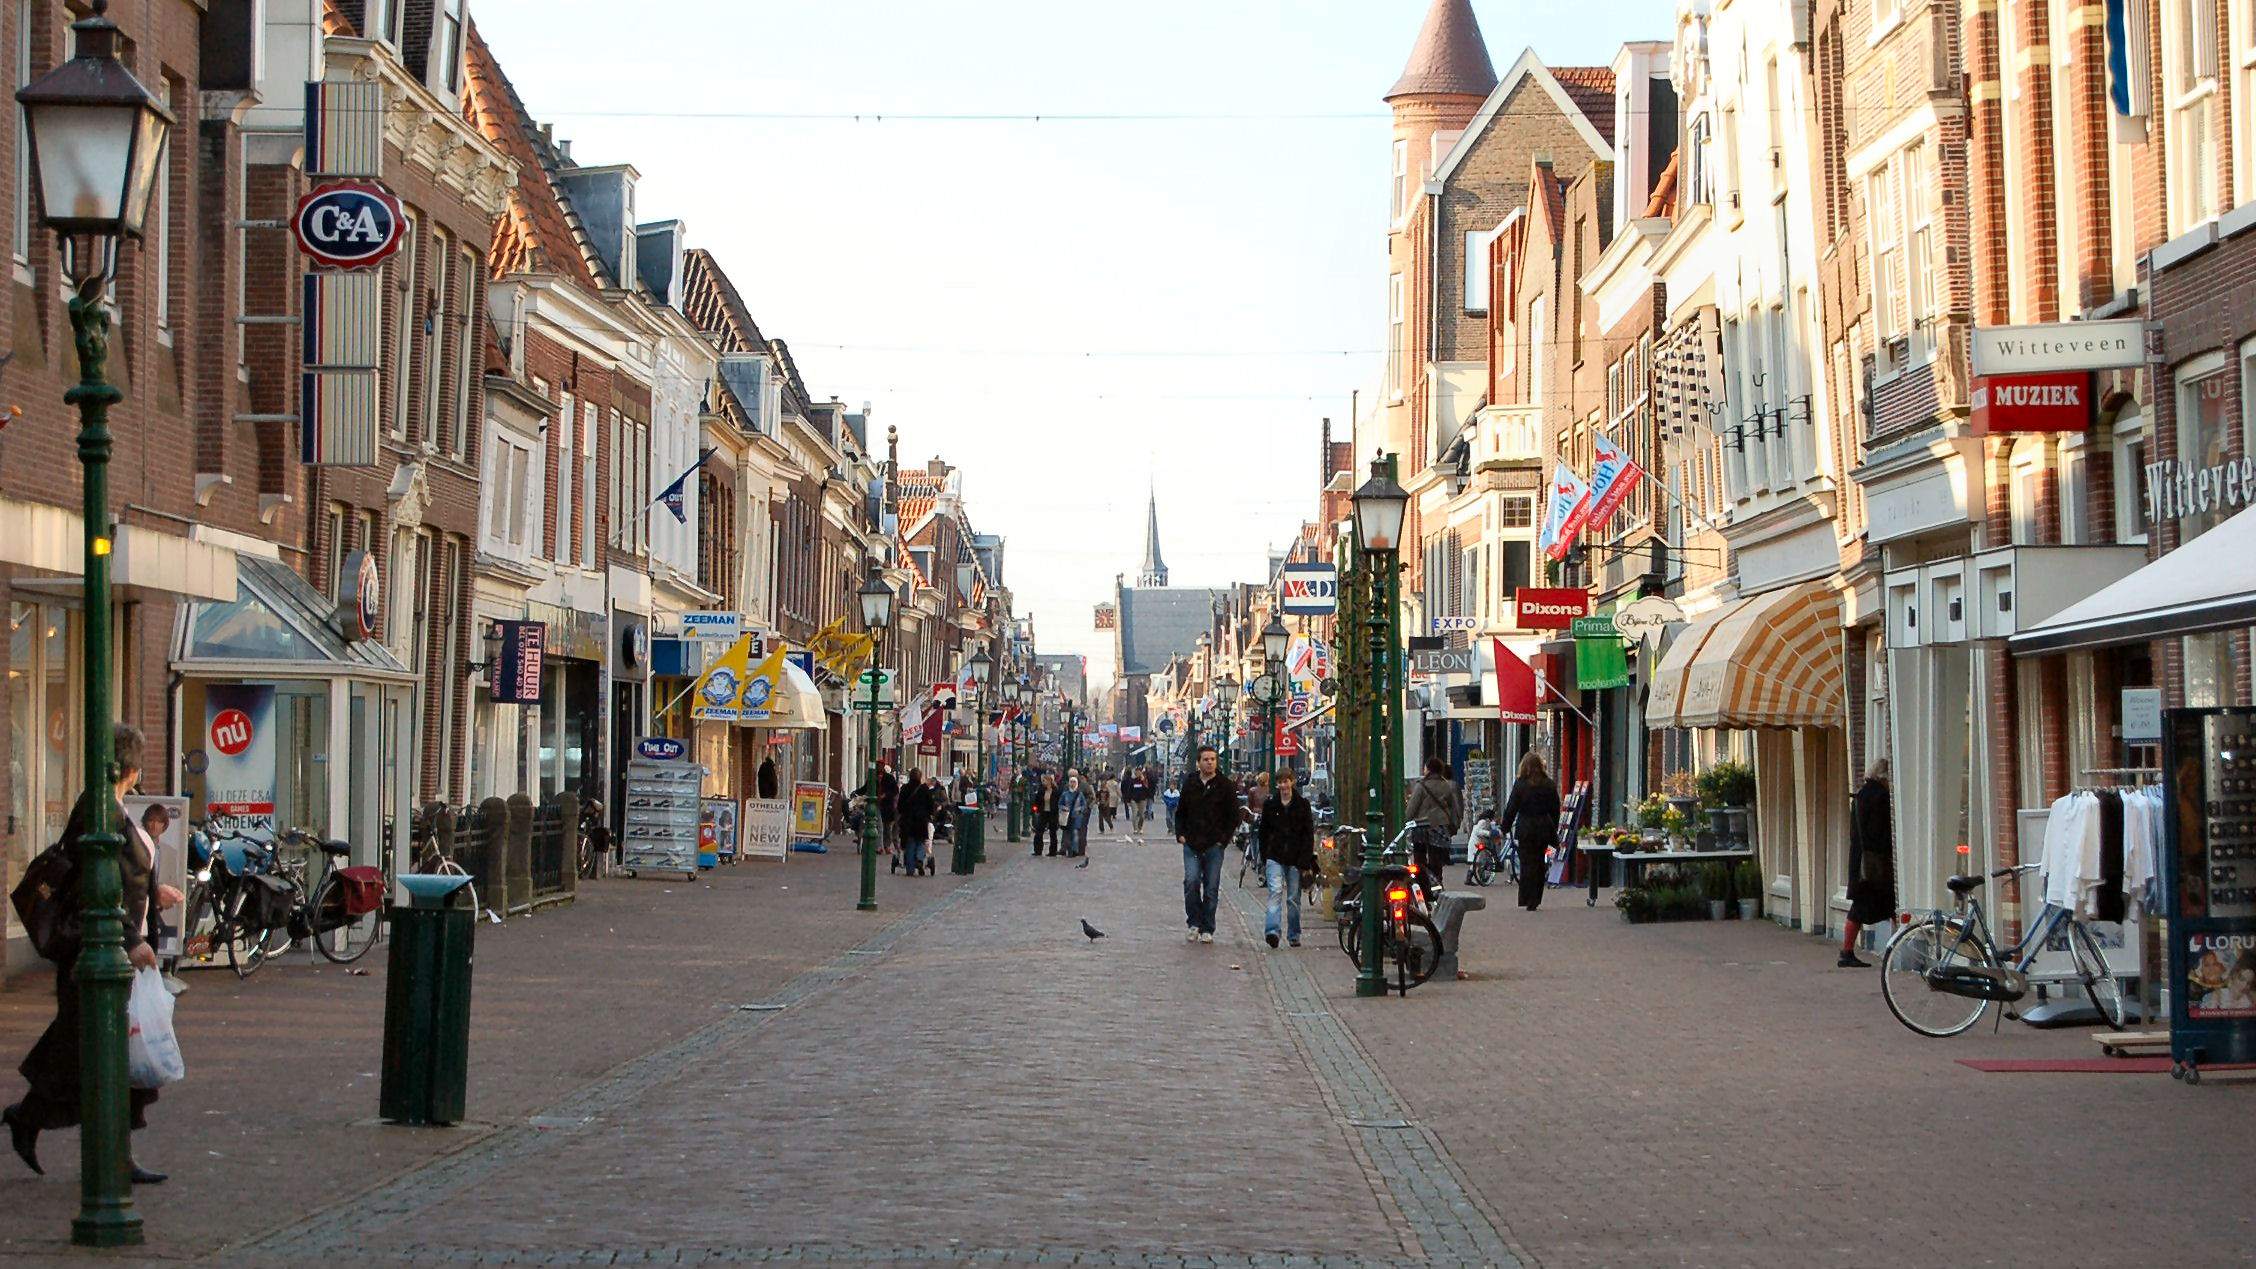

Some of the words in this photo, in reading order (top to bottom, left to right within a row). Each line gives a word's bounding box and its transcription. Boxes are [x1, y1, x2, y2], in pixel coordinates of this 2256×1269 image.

[311, 205, 383, 242] C&A
[1997, 338, 2127, 357] Witteveen
[1995, 384, 2081, 407] MUZIEK
[1286, 579, 1332, 599] V&D
[1521, 601, 1584, 617] Dixons
[683, 615, 735, 624] ZEEMAN
[1432, 618, 1476, 629] EXPO
[1575, 619, 1615, 632] Prima
[527, 628, 541, 648] TE
[526, 651, 540, 697] HUUR
[705, 708, 737, 716] ZEEMAN
[1502, 711, 1536, 722] Dixons
[209, 790, 224, 802] BIJ
[226, 790, 247, 802] DEZE
[251, 790, 272, 802] C&A
[749, 802, 785, 810] OTHELLO
[219, 814, 272, 829] HOENEN
[751, 824, 781, 834] NEW
[750, 833, 781, 843] NEW
